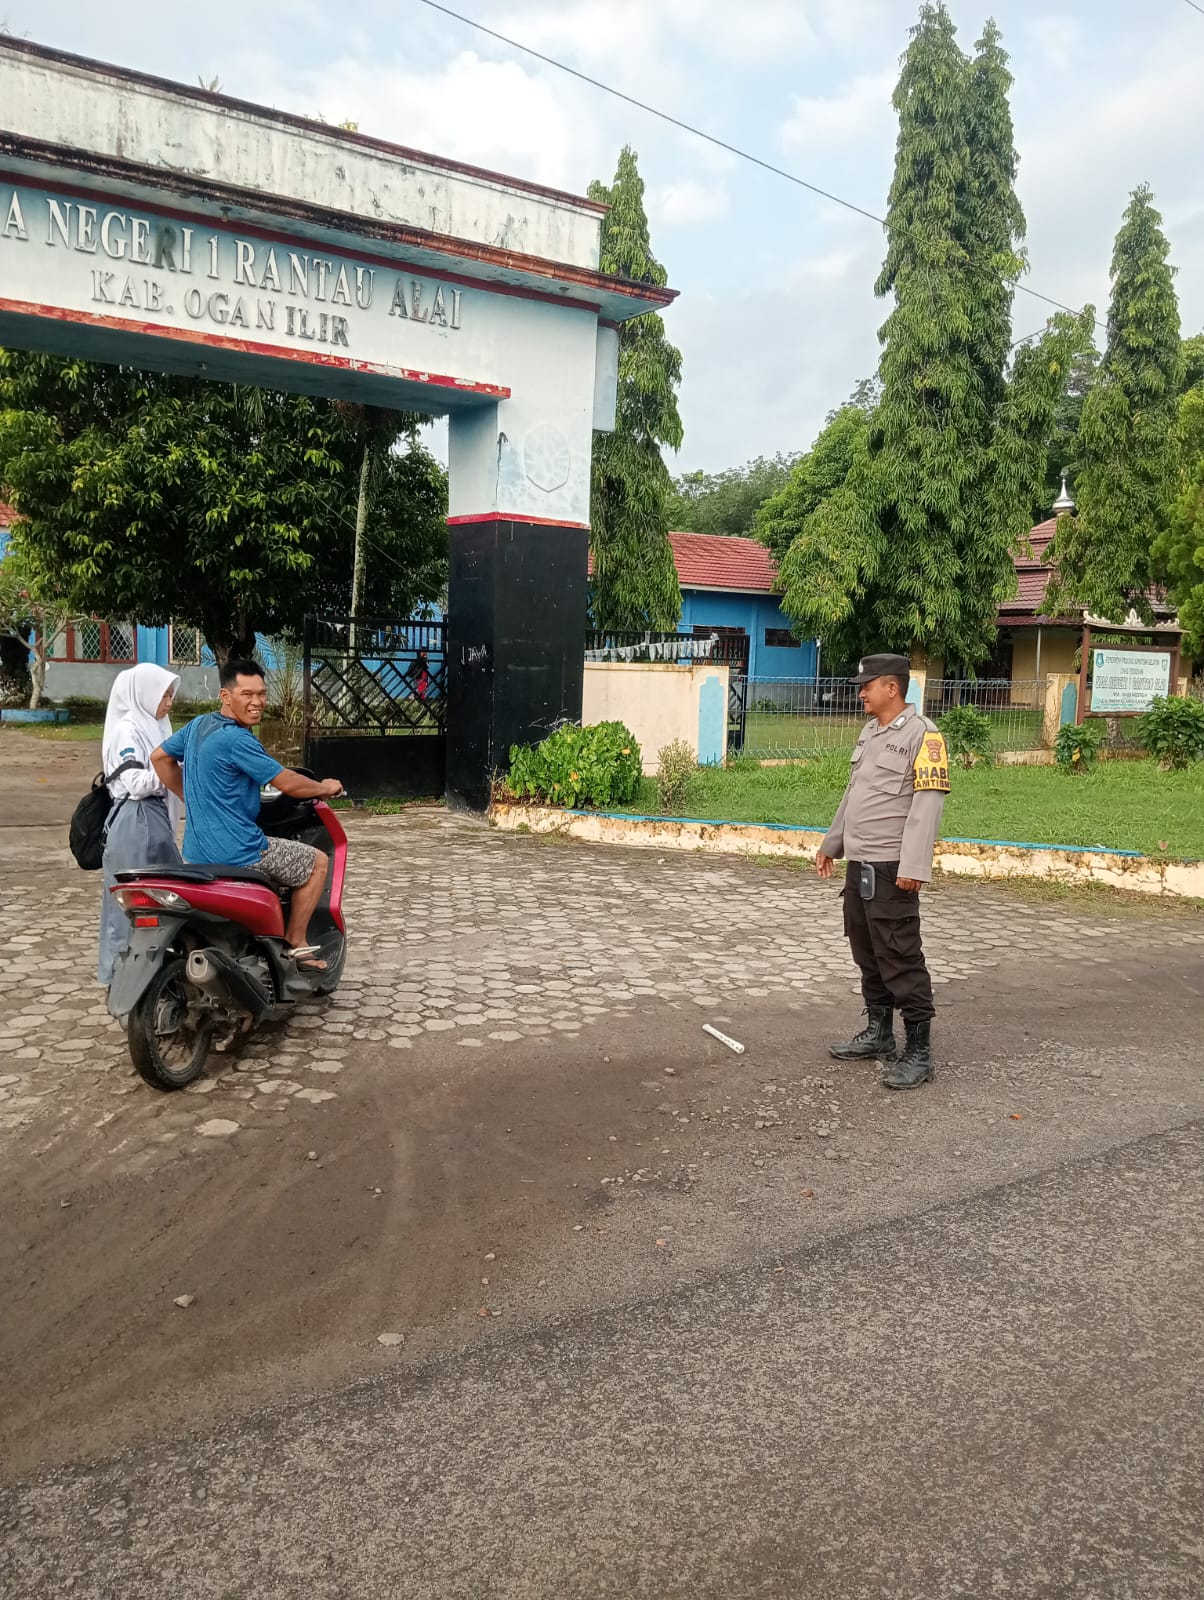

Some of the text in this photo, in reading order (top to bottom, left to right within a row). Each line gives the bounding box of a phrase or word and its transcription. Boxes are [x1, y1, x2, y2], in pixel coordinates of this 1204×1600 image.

[45, 198, 194, 274] NEGERI
[207, 235, 220, 280] 1
[233, 239, 375, 310] RANTAU
[388, 277, 463, 330] ALAI
[91, 269, 350, 347] KAB. OGAN ILIR
[885, 743, 908, 756] POLRI
